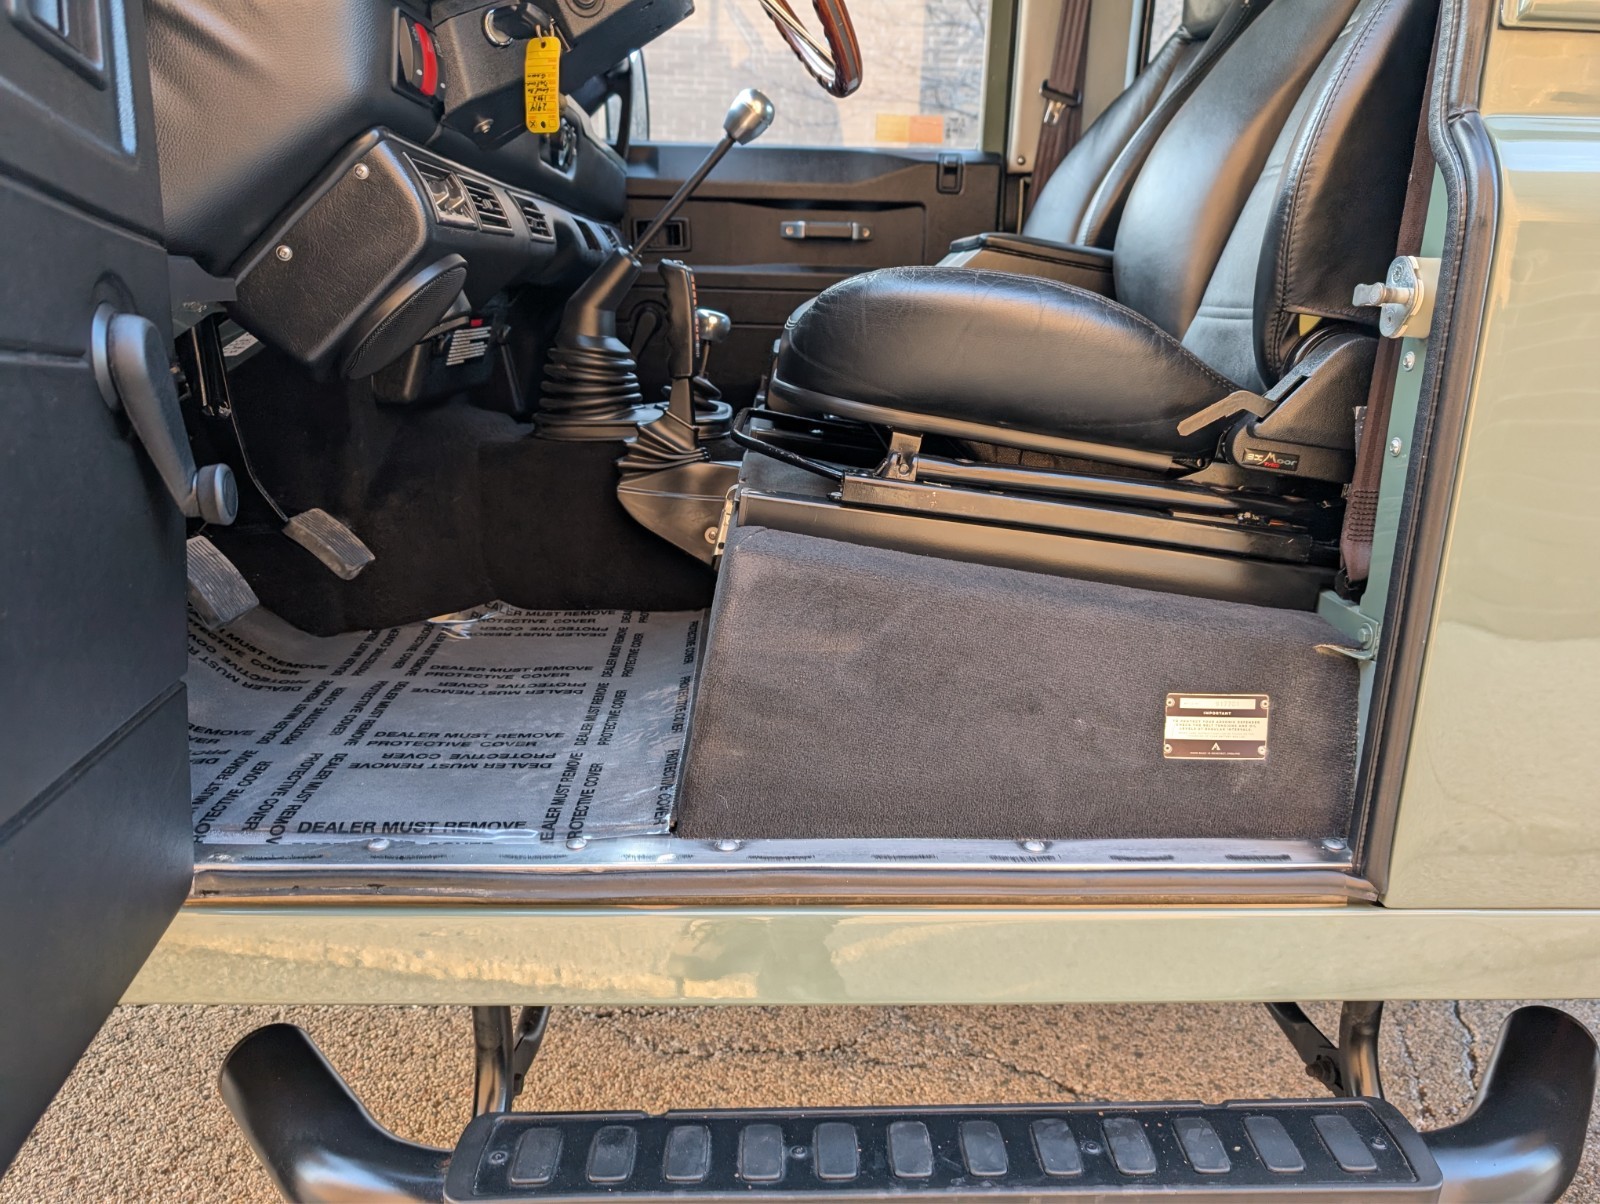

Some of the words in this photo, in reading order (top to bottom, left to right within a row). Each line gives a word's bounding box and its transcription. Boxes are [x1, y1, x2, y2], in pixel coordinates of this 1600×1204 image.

[484, 601, 522, 616] EALER
[564, 609, 616, 617] REMOVE
[187, 631, 217, 653] COV
[226, 632, 267, 656] MUST
[267, 656, 329, 669] REMOVE
[200, 656, 240, 683] MUST
[250, 658, 300, 675] COVER
[424, 671, 515, 680] PROTECTIVE
[430, 664, 486, 672] DEALER
[242, 681, 302, 692] DEALER
[320, 686, 348, 706] COVER
[591, 682, 610, 704] REMOVE
[368, 701, 391, 719] MUST
[584, 706, 601, 723] MUST
[597, 709, 621, 746] PROTECTIVE
[611, 689, 628, 710] COVER
[329, 714, 358, 736] COVER
[344, 719, 376, 746] REMOVE
[574, 723, 593, 746] DEALER
[216, 749, 259, 780] REMOVE
[237, 760, 273, 786] COVER
[271, 752, 324, 797] PROTECTIVE
[314, 753, 348, 780] DEALER
[296, 780, 323, 804] MUST
[540, 808, 562, 841] EALER
[551, 785, 571, 808] MUST
[562, 752, 583, 783] REMOVE
[567, 789, 595, 839] ROTECTIVE
[584, 763, 604, 787] COVER
[241, 798, 279, 831] COVER
[266, 804, 302, 844] REMOV
[297, 821, 376, 834] DEALER
[381, 821, 441, 834] MUST
